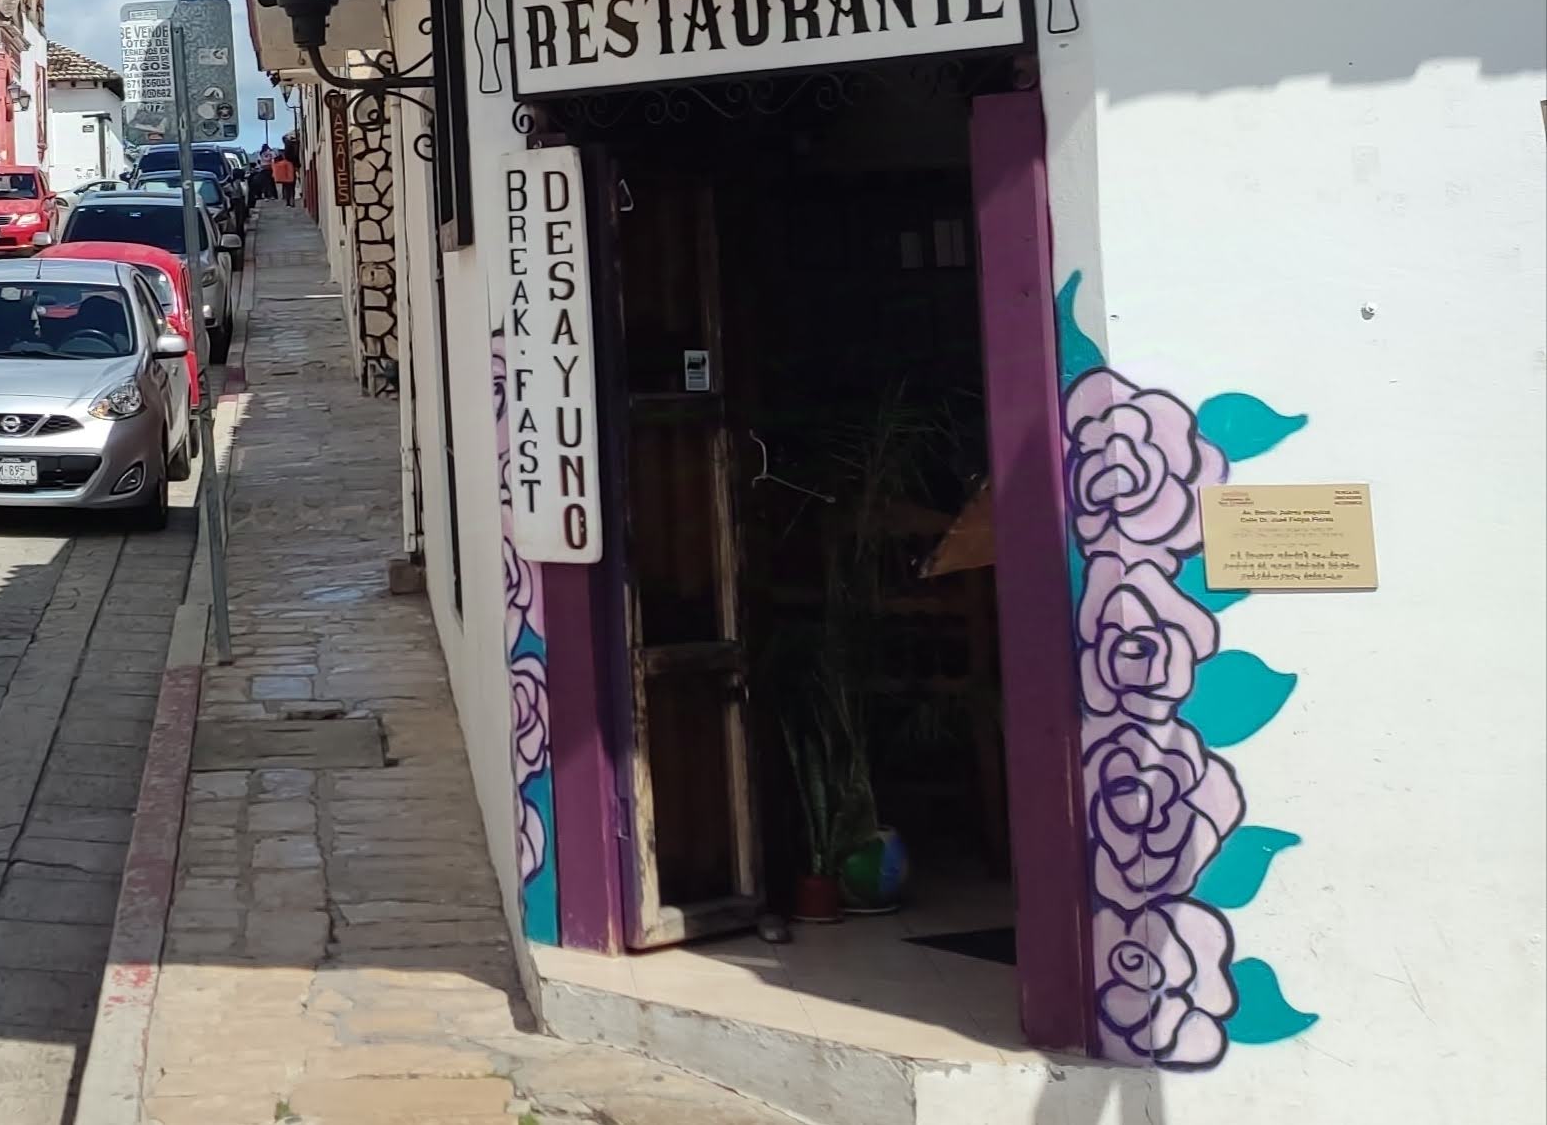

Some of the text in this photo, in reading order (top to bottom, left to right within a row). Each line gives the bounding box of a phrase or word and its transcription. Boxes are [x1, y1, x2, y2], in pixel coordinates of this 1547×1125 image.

[134, 25, 169, 38] VENDE
[155, 38, 169, 47] DE
[122, 61, 171, 72] PAGOS
[332, 96, 350, 203] MASAJES
[543, 170, 589, 550] DESAYUNO
